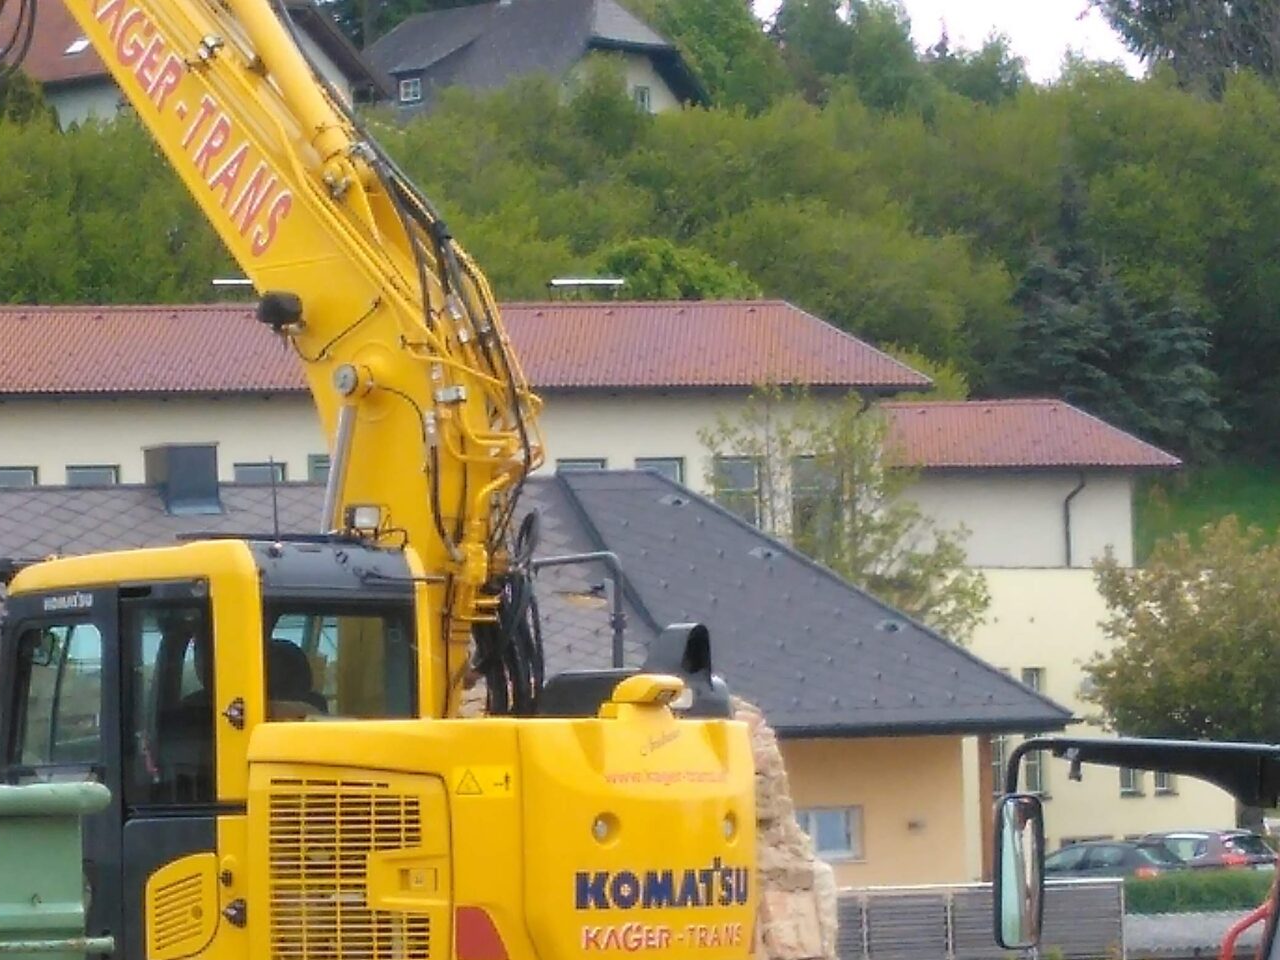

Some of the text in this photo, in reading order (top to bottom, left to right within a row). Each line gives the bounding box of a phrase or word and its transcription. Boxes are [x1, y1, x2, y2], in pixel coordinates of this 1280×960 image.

[90, 0, 294, 258] AGER-TRANS
[44, 591, 93, 611] KOMATSU
[574, 856, 749, 910] KOMATSU
